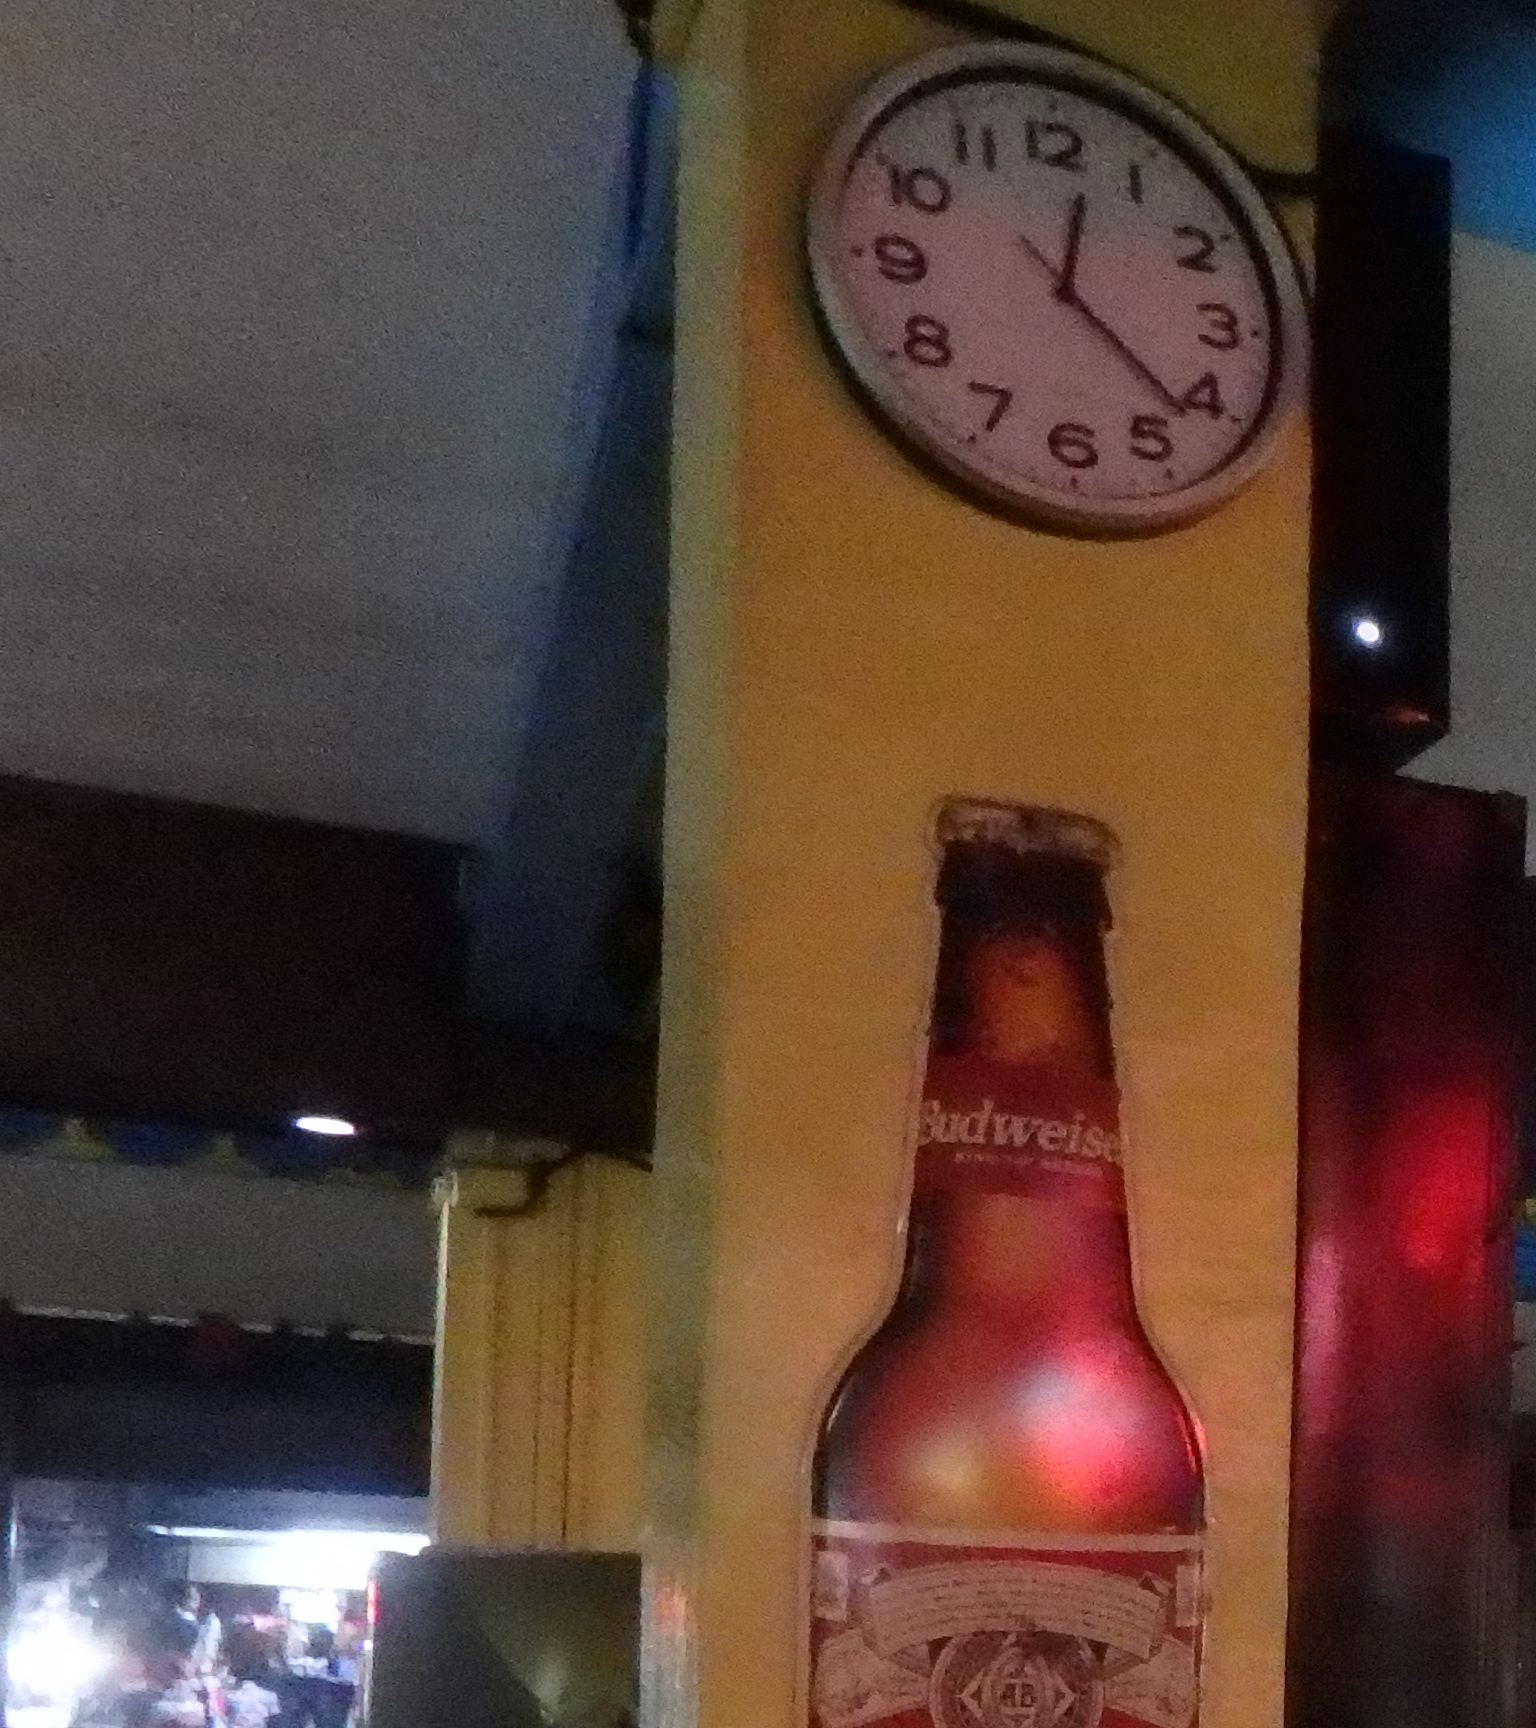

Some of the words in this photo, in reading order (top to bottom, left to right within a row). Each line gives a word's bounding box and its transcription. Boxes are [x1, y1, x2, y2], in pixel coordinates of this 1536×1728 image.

[953, 118, 996, 172] 11
[1025, 120, 1086, 171] 12
[887, 166, 952, 214] 10
[1129, 164, 1142, 203] 1
[873, 235, 929, 283] 9
[1172, 226, 1217, 273] 2
[903, 315, 952, 367] 8
[1196, 302, 1239, 350] 3
[968, 379, 1014, 433] 7
[1177, 372, 1225, 422] 4
[1047, 423, 1100, 469] 6
[1129, 413, 1175, 461] 5
